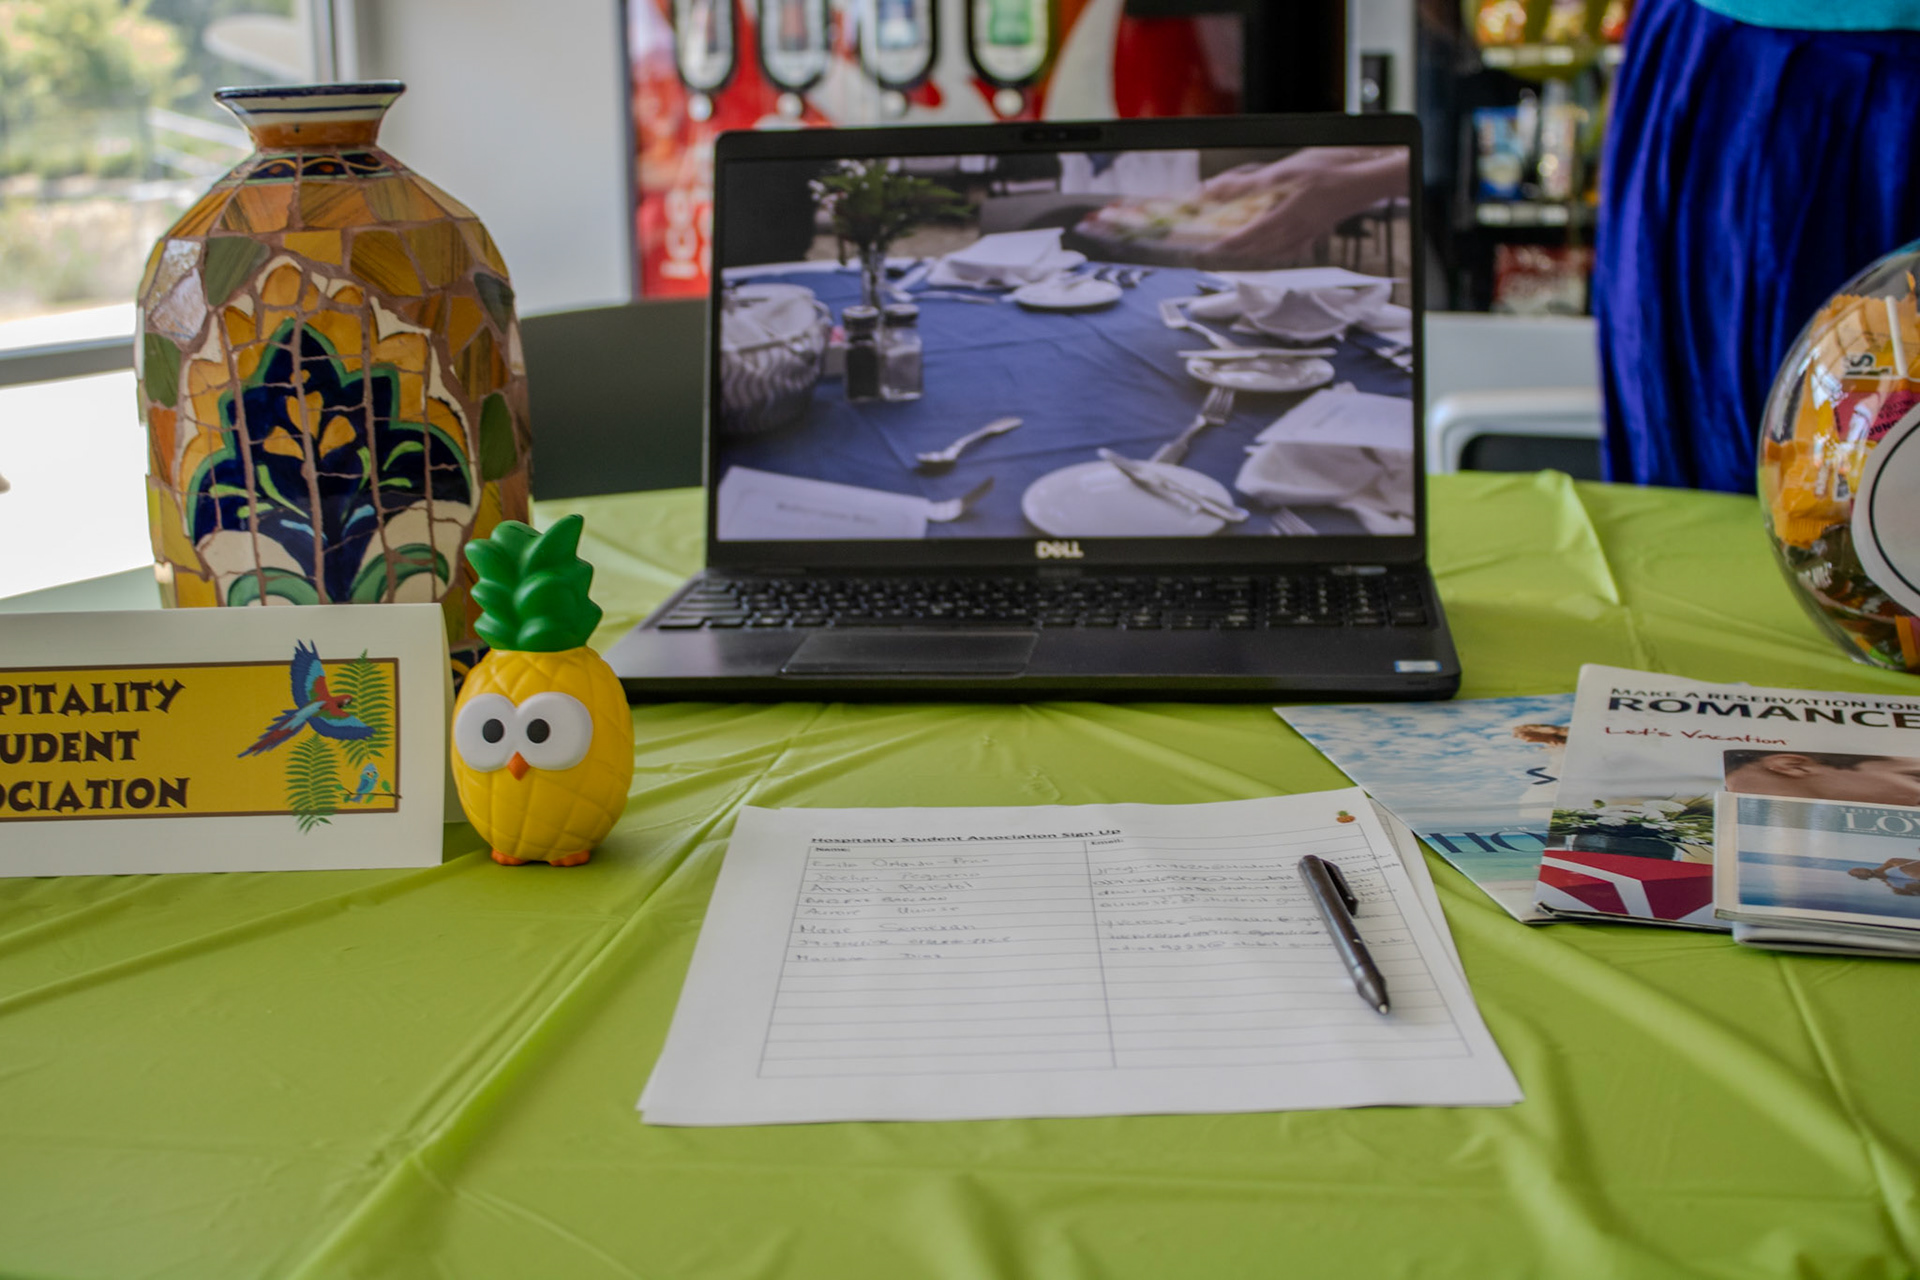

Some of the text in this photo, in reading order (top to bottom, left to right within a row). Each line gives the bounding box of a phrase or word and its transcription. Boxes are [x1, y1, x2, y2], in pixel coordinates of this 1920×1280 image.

[1036, 540, 1084, 558] DELL
[1611, 687, 1920, 712] MAKE A RESERVATION FOR
[1608, 697, 1920, 730] ROMANCE
[0, 729, 140, 764] UDENT
[1605, 726, 1787, 746] Let's Vacation
[810, 836, 896, 844] Hospitality
[901, 835, 963, 843] Student
[967, 832, 1057, 842] Association
